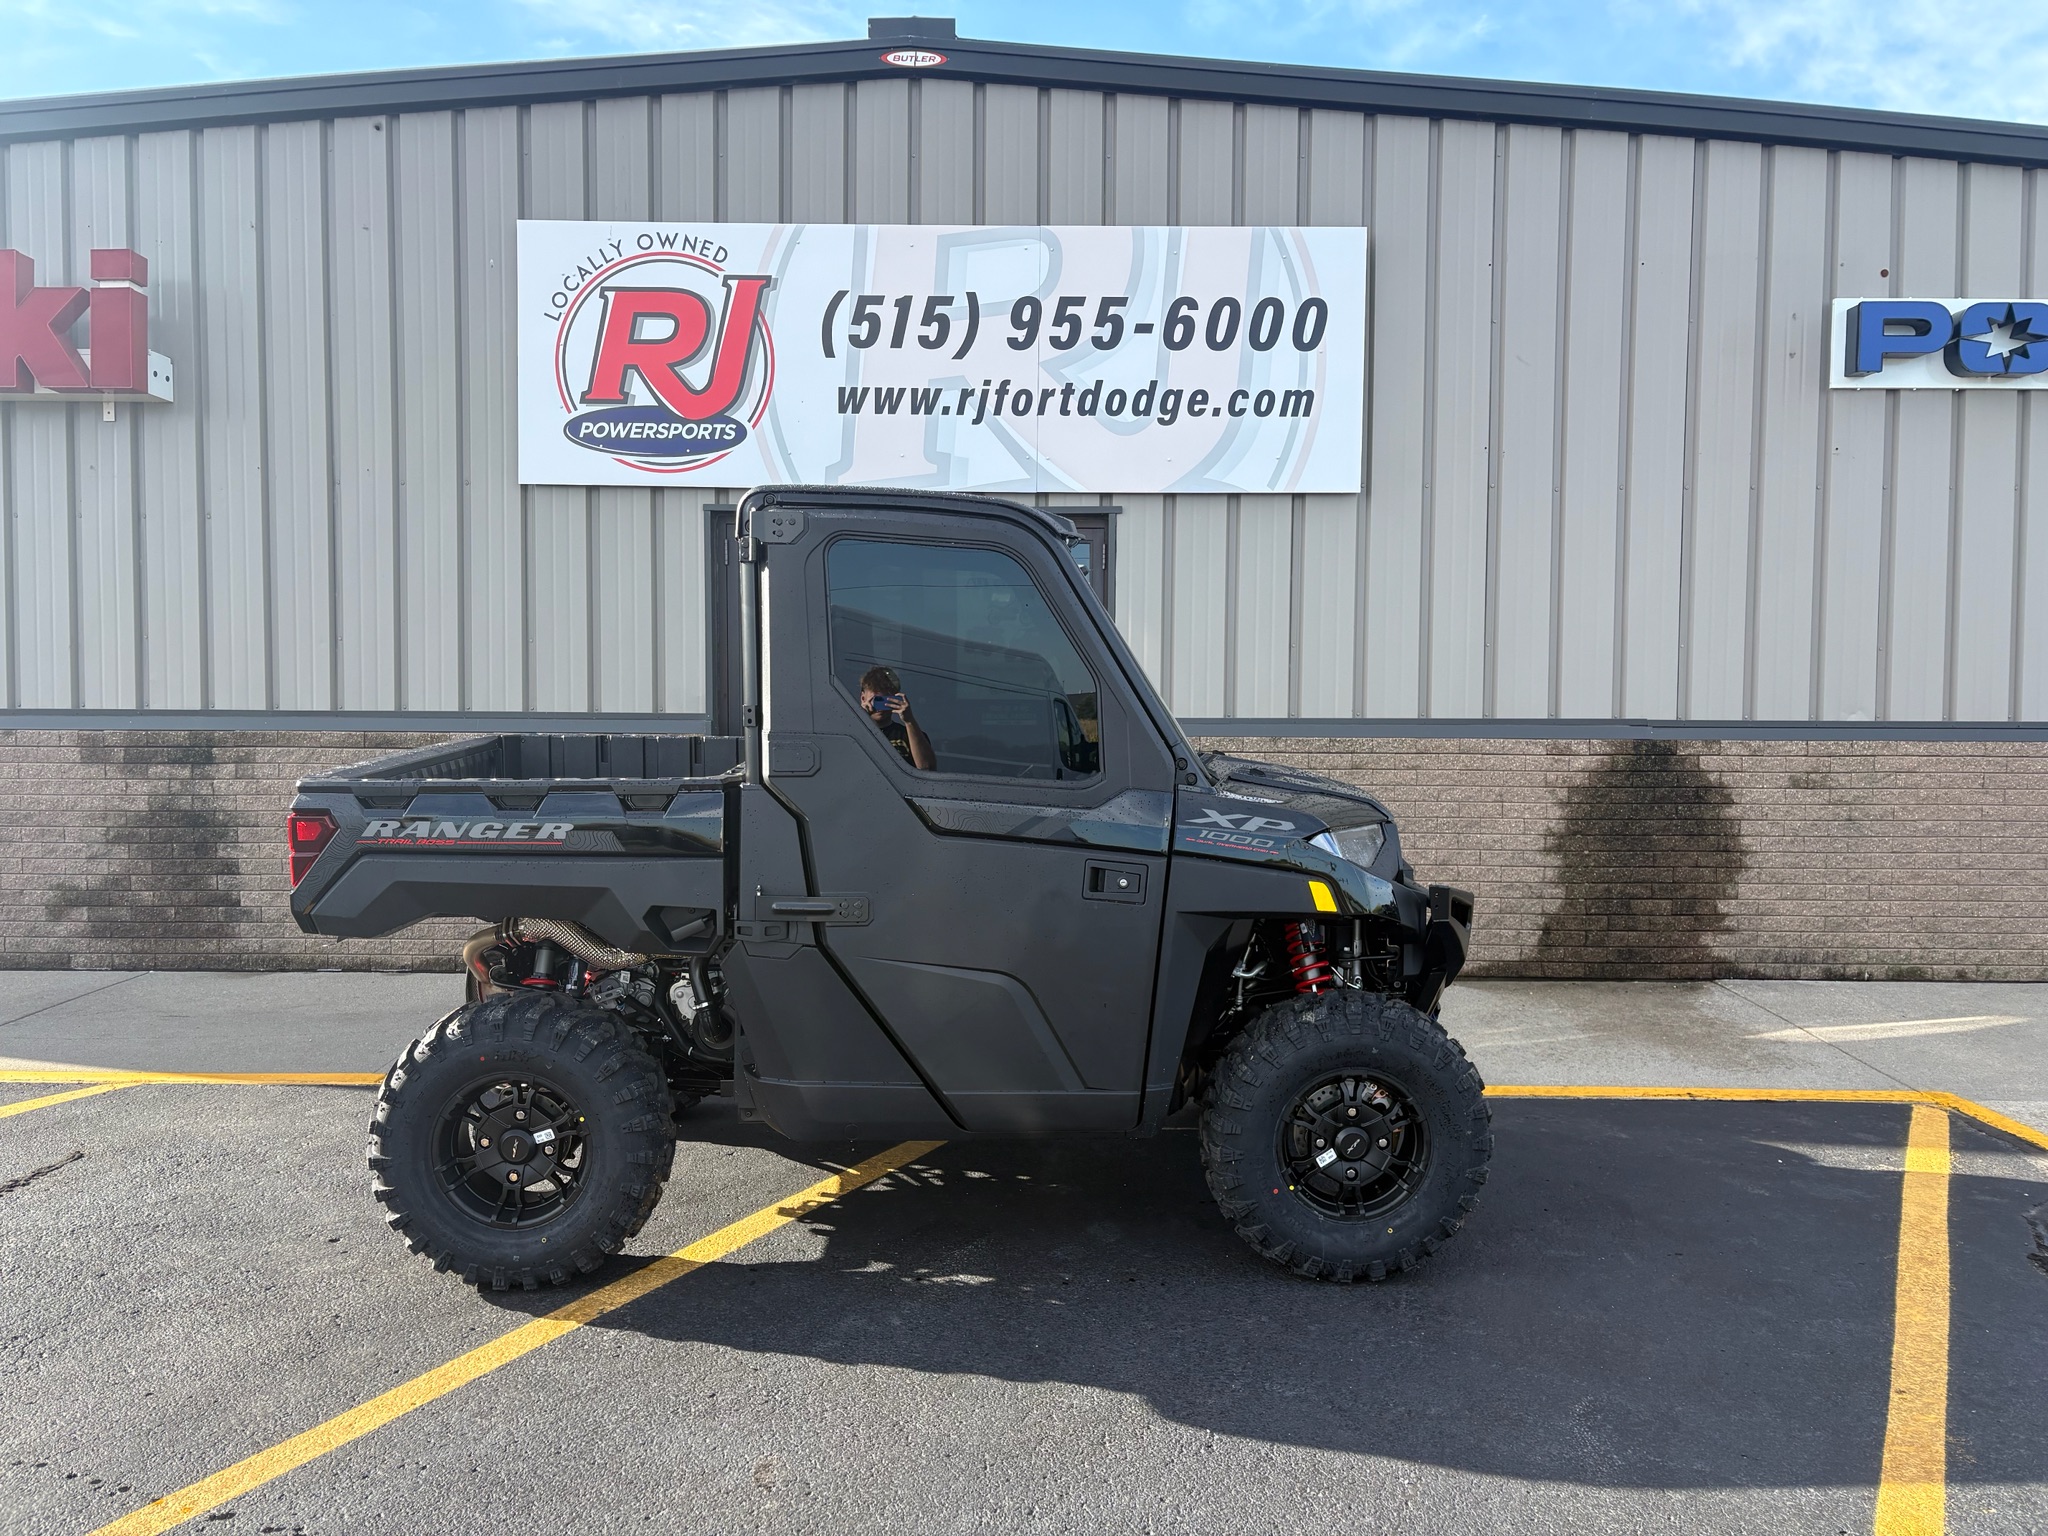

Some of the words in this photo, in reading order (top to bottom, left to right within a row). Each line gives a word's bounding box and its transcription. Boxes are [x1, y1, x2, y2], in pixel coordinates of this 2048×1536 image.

[892, 54, 937, 63] BUTLER
[543, 239, 624, 322] LOCALLY
[637, 231, 729, 264] OWNED
[821, 290, 980, 360] (515)
[1006, 296, 1329, 352] 955-6000
[579, 274, 774, 421] RJ
[837, 379, 1316, 426] www.rjfortdodge.com
[579, 421, 737, 441] POWERSPORTS
[361, 821, 574, 839] RANGER
[1185, 808, 1296, 831] XP
[1199, 829, 1275, 847] 1000
